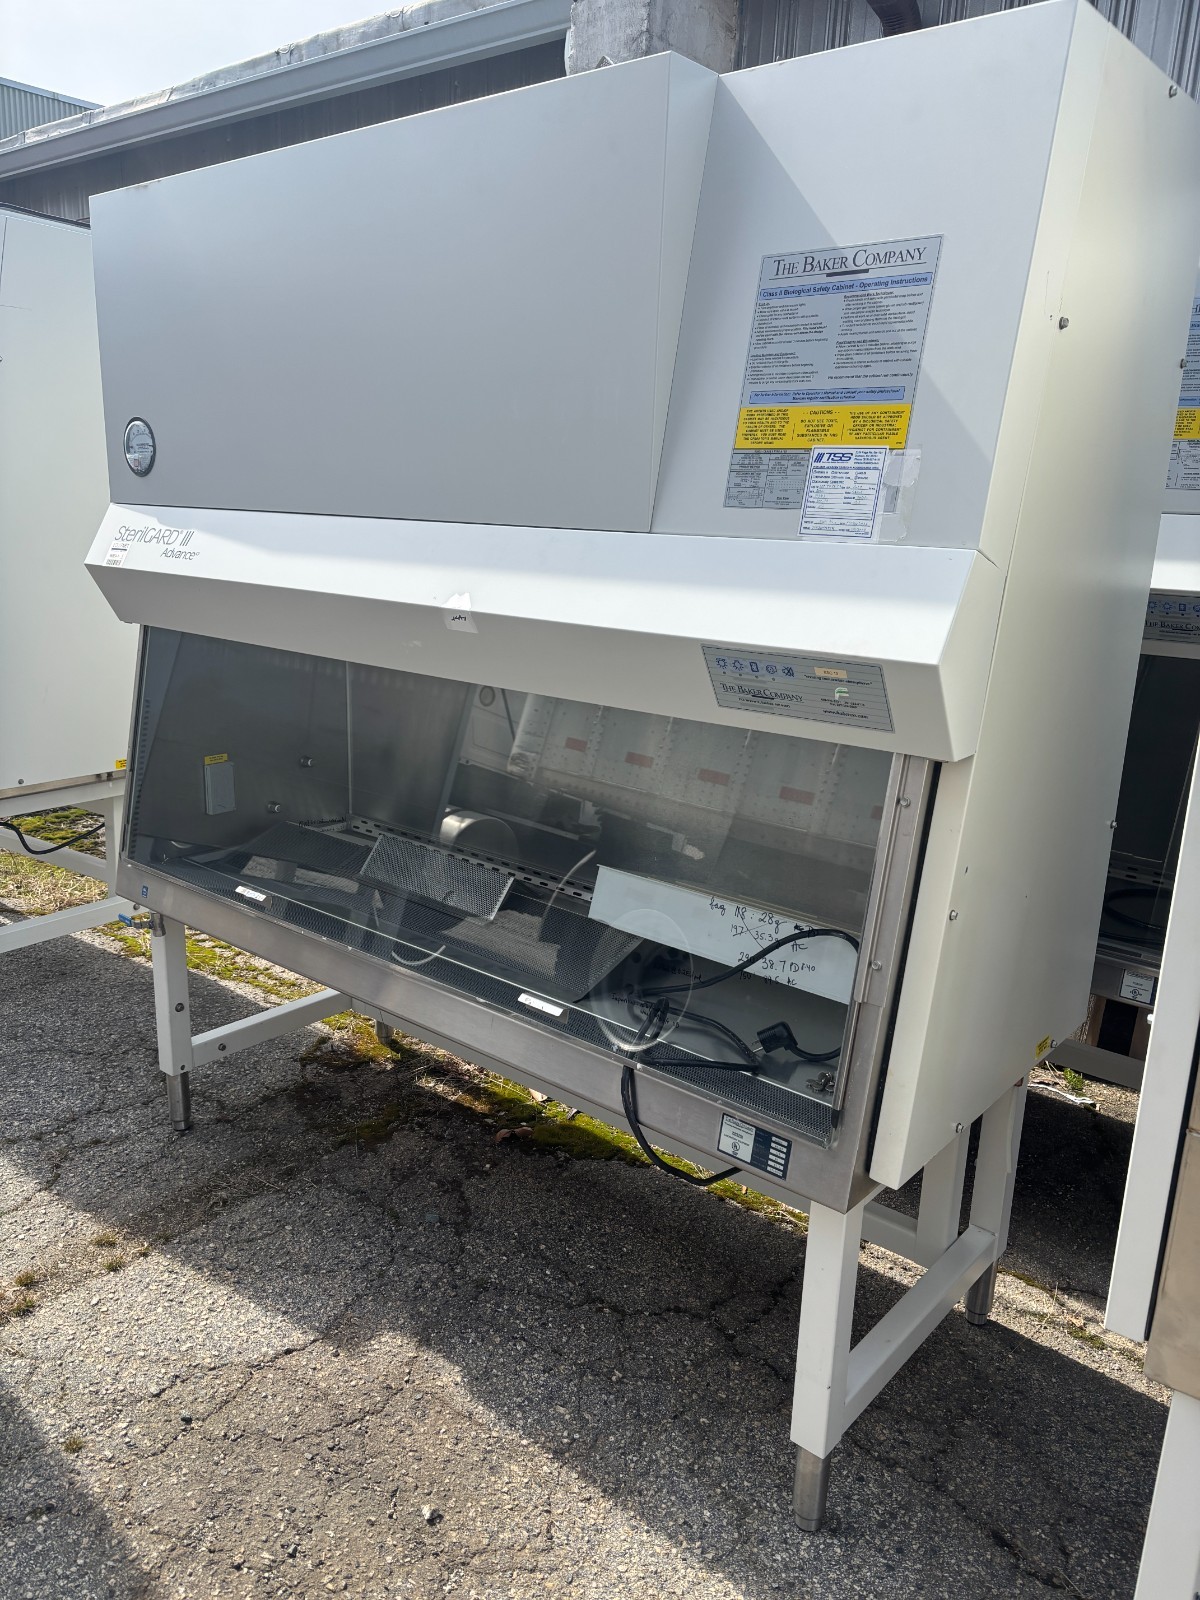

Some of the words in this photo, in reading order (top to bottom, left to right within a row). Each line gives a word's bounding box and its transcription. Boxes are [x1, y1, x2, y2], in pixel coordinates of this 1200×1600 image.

[773, 259, 800, 277] THE
[801, 255, 848, 274] BAKER
[852, 246, 928, 268] COMPANY
[783, 287, 812, 296] Biological
[812, 285, 831, 294] Safety
[832, 283, 855, 291] Cabinet
[859, 280, 889, 289] Operating
[890, 276, 928, 285] Instructions
[825, 452, 854, 462] TSS
[719, 682, 736, 692] THE
[737, 685, 762, 696] BAKER
[763, 688, 803, 702] COMPANY
